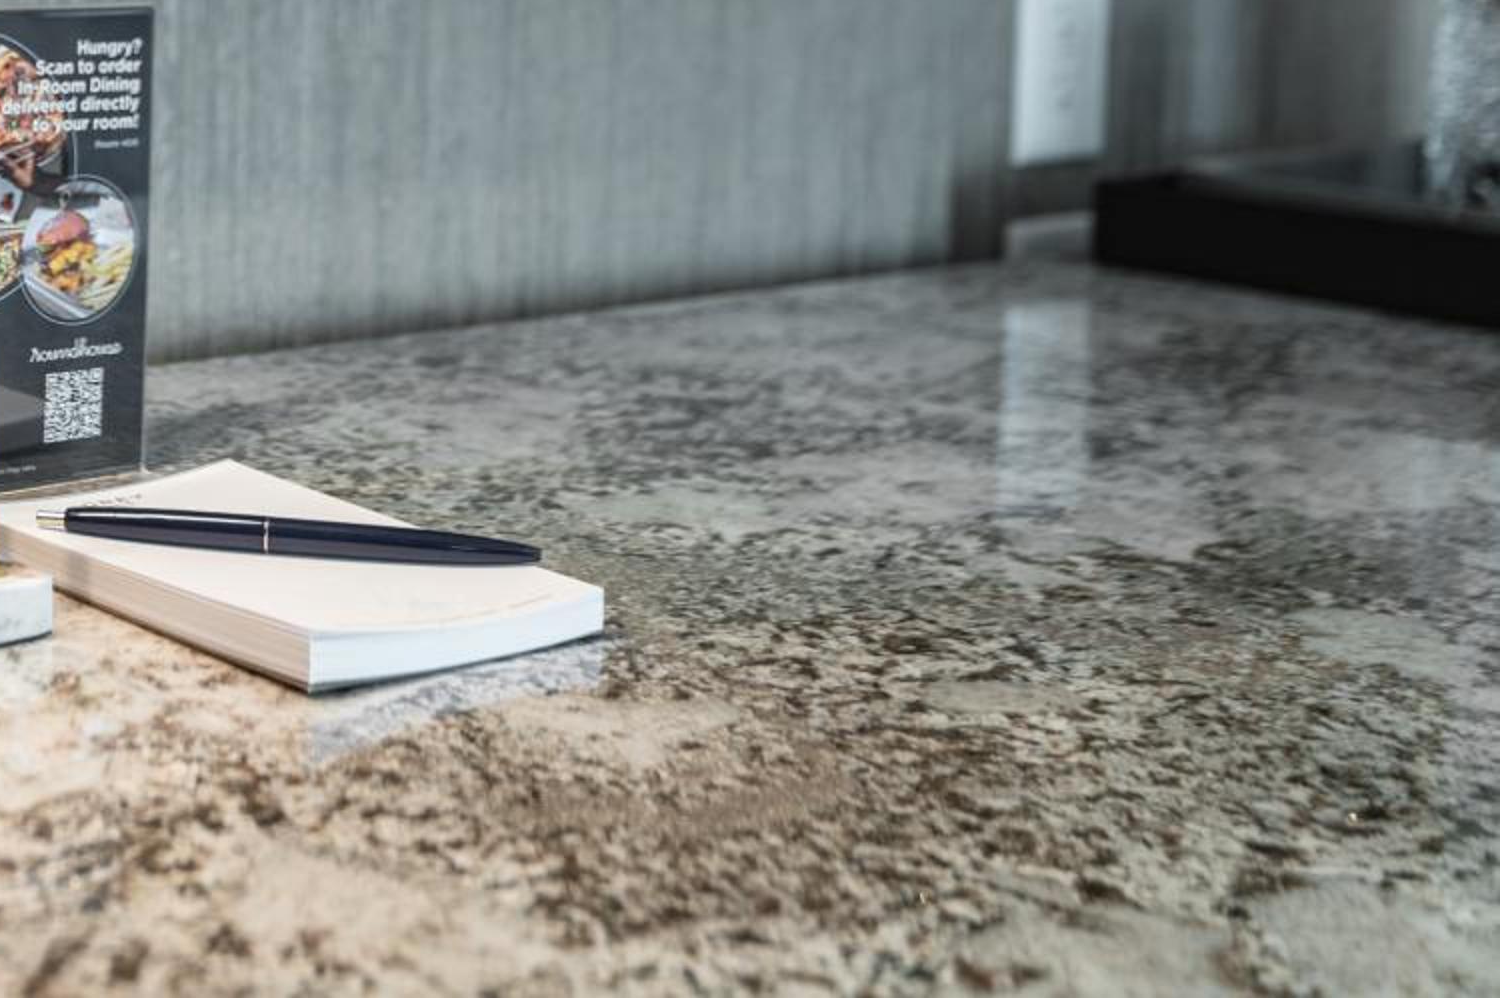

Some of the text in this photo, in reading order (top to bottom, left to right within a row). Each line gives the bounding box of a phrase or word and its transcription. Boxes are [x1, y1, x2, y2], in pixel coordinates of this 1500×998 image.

[76, 38, 142, 57] Hungry?
[36, 58, 142, 76] Scan to order
[17, 77, 141, 94] In-Room Dining
[3, 95, 141, 115] delivered directly
[32, 114, 140, 136] to your room!
